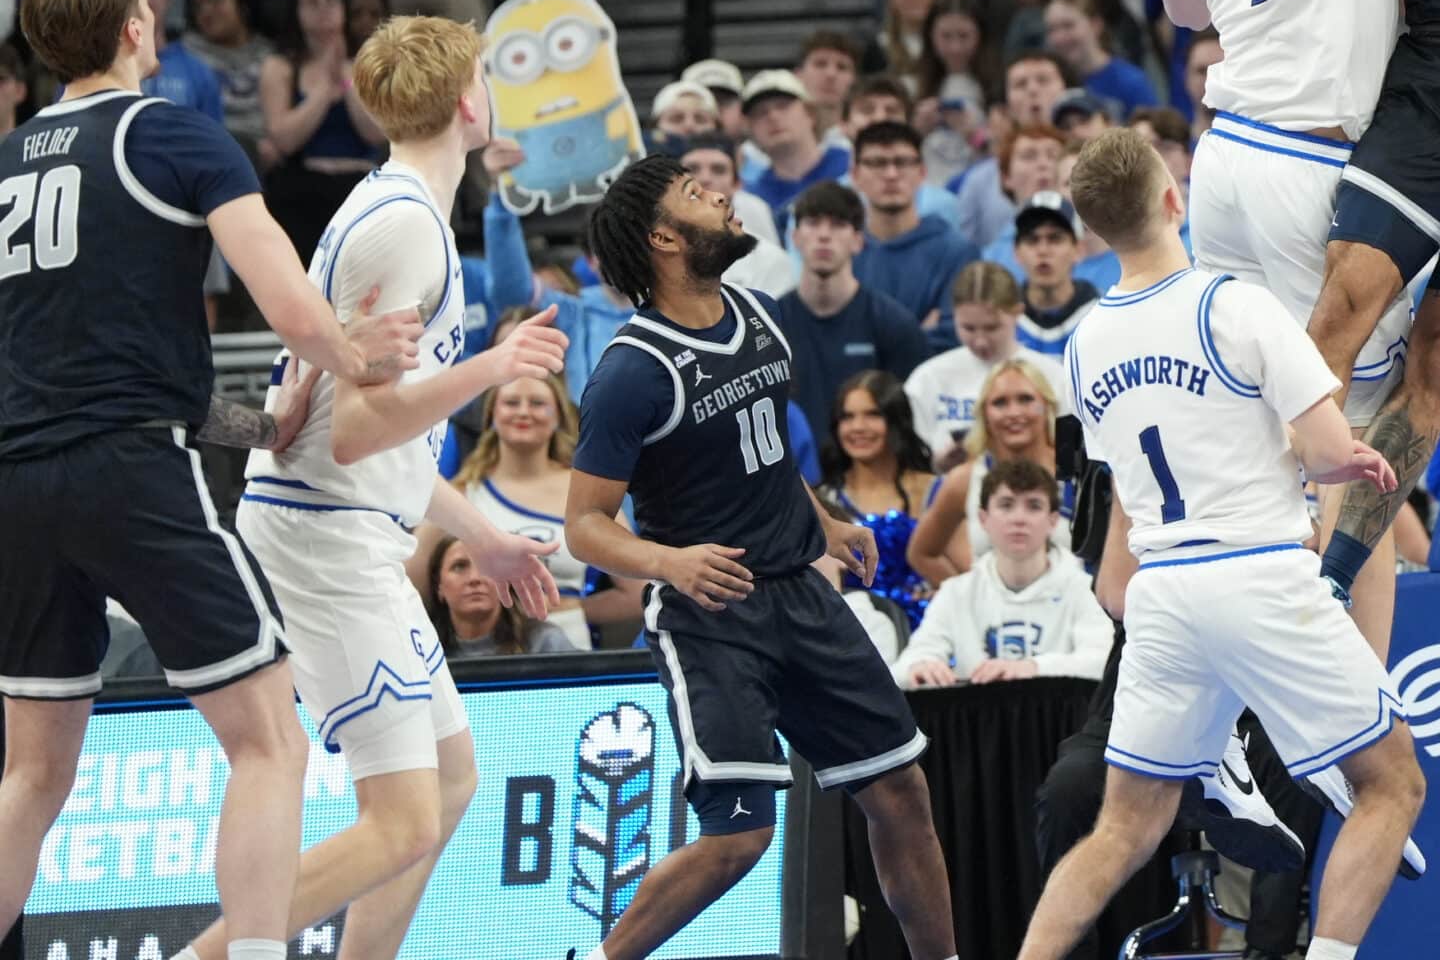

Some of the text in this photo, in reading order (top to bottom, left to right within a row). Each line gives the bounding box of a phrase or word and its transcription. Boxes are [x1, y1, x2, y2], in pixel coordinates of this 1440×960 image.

[23, 126, 79, 163] FIELDER
[0, 164, 82, 281] 20
[692, 359, 791, 424] GEORGETOWN
[1084, 355, 1210, 423] ASHWORTH
[736, 396, 785, 474] 10
[1138, 424, 1186, 525] 1
